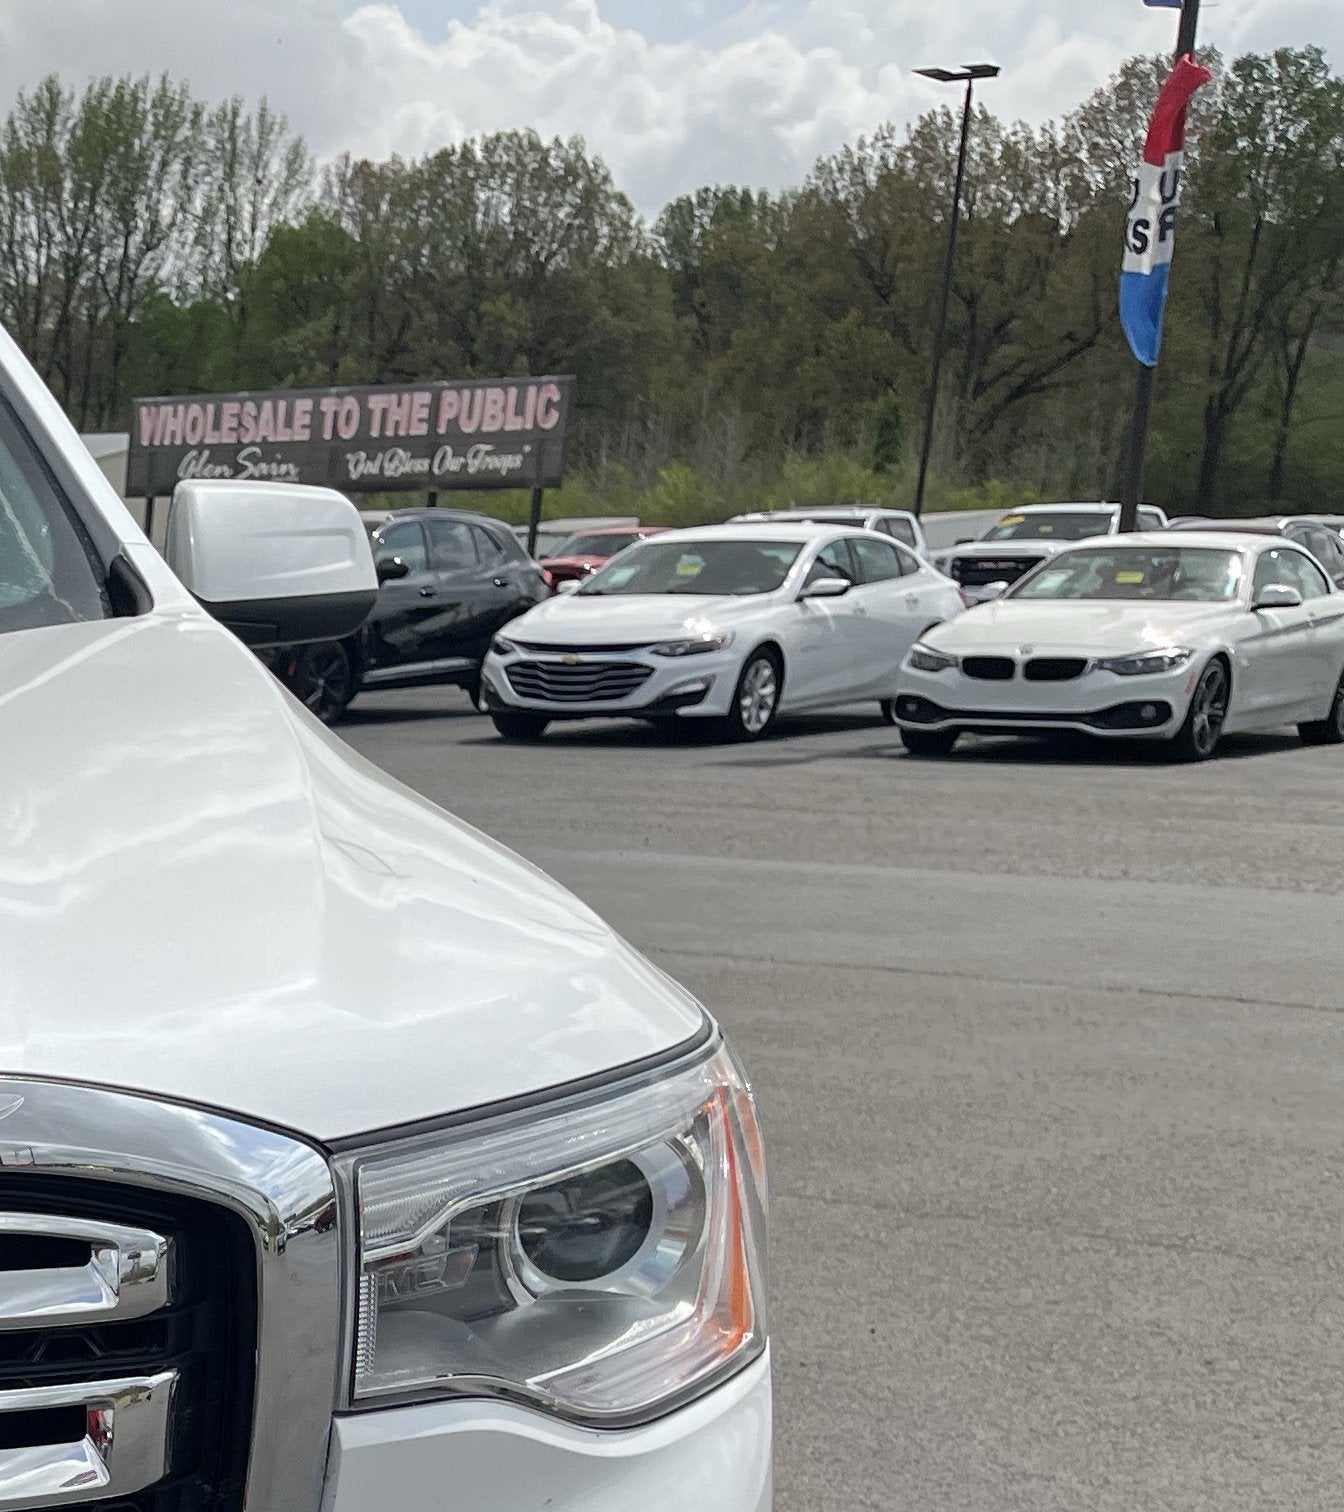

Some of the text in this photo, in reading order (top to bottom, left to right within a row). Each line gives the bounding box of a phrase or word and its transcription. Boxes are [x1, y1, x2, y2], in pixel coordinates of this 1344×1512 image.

[139, 383, 561, 446] WHOLESALE TO THE PUBLIC
[431, 444, 467, 476] Our
